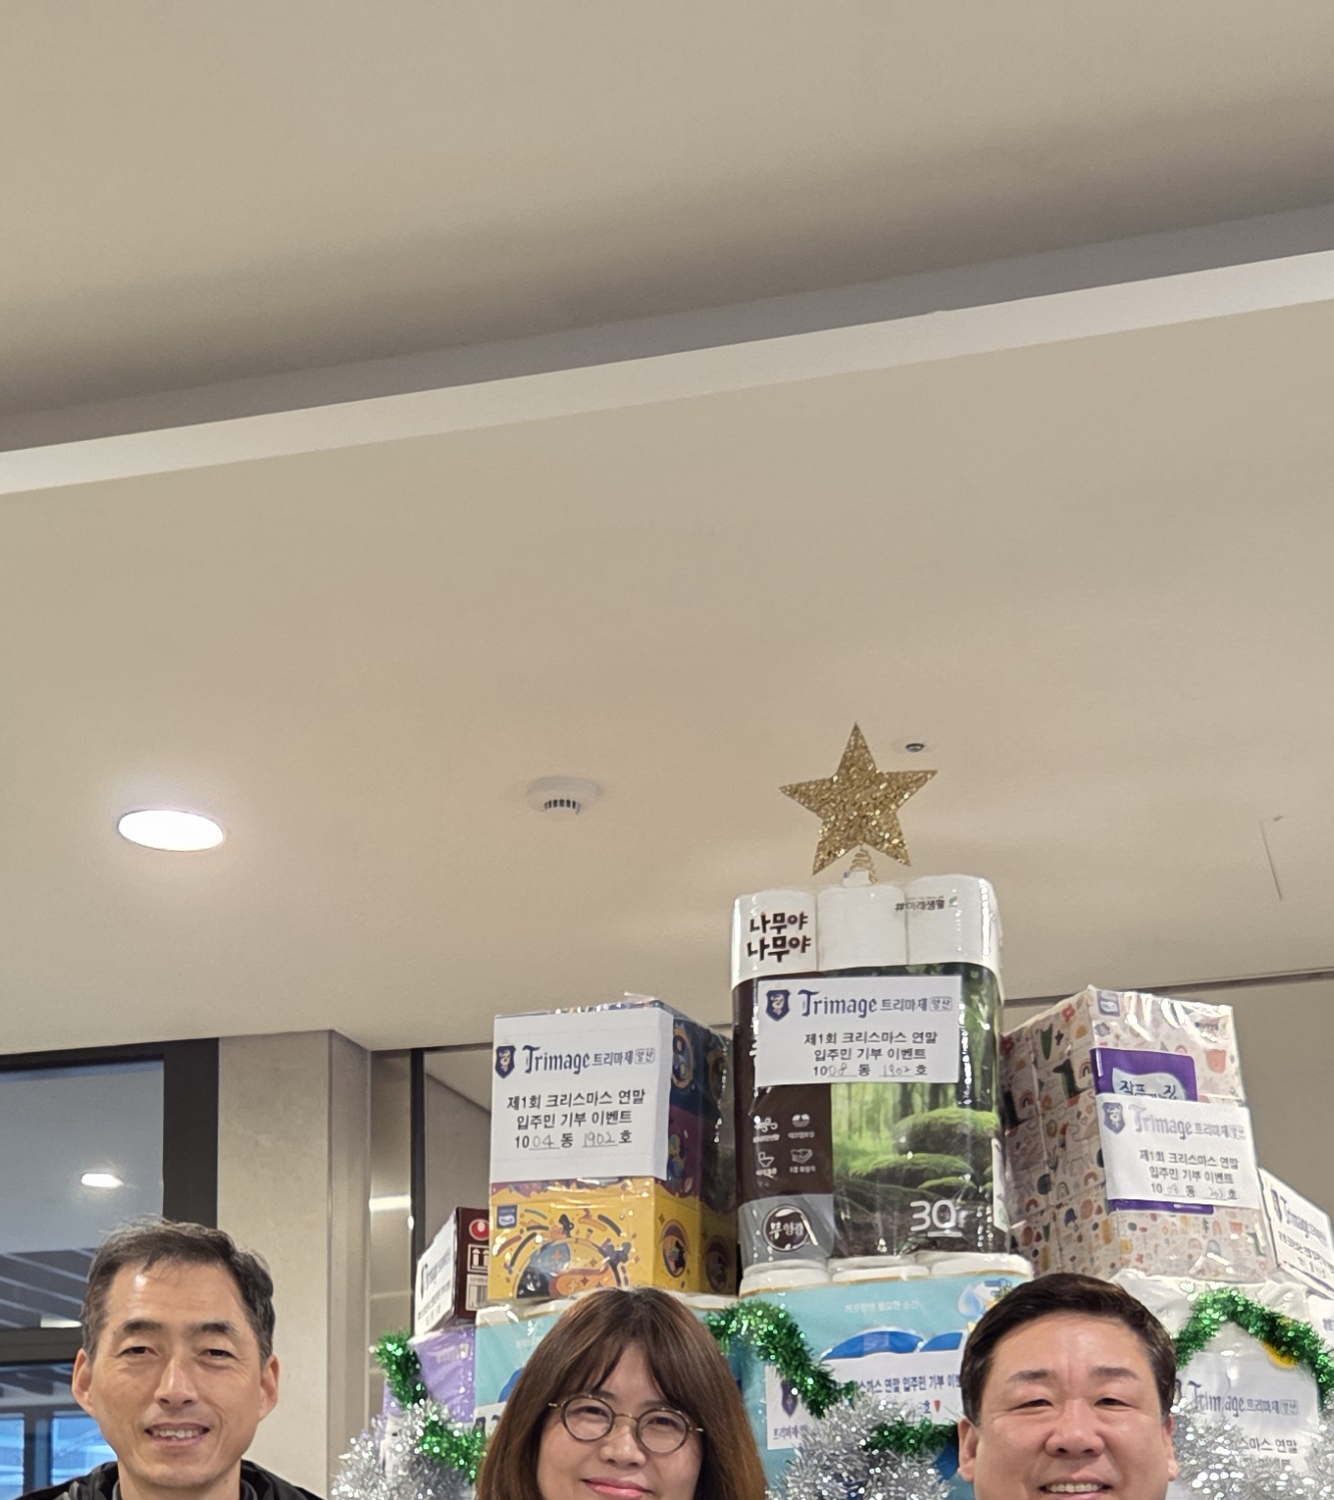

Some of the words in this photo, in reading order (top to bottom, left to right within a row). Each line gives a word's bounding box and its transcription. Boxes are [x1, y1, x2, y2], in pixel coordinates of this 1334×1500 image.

[749, 911, 809, 934] 나무야
[746, 935, 812, 963] 나무야
[798, 989, 878, 1018] Trimage
[804, 1033, 837, 1045] 제1회
[842, 1032, 907, 1044] 크리스마스
[912, 1031, 938, 1044] 연말
[522, 1045, 590, 1075] Trimage
[814, 1049, 852, 1061] 입주민
[857, 1048, 883, 1061] 기부
[887, 1048, 927, 1060] 이벤트
[858, 1065, 870, 1076] 동
[915, 1064, 928, 1076] 호
[507, 1094, 542, 1110] 제1회
[545, 1091, 612, 1108] 크리스마스
[618, 1088, 646, 1105] 연말
[517, 1114, 556, 1130] 입주민
[560, 1112, 587, 1127] 기부
[591, 1110, 632, 1125] 이벤트
[1128, 1104, 1193, 1140] Trimage
[560, 1133, 573, 1148] 동
[618, 1130, 632, 1144] 호
[1139, 1149, 1165, 1163] 제1회
[1168, 1152, 1218, 1167] 크리스마스
[1220, 1157, 1239, 1170] 연말
[1149, 1166, 1179, 1180] 입주민
[1182, 1169, 1201, 1182] 기부
[1204, 1172, 1234, 1185] 이벤트
[1185, 1185, 1196, 1198] 동
[1228, 1188, 1238, 1200] 호
[1274, 1437, 1298, 1454] 연말
